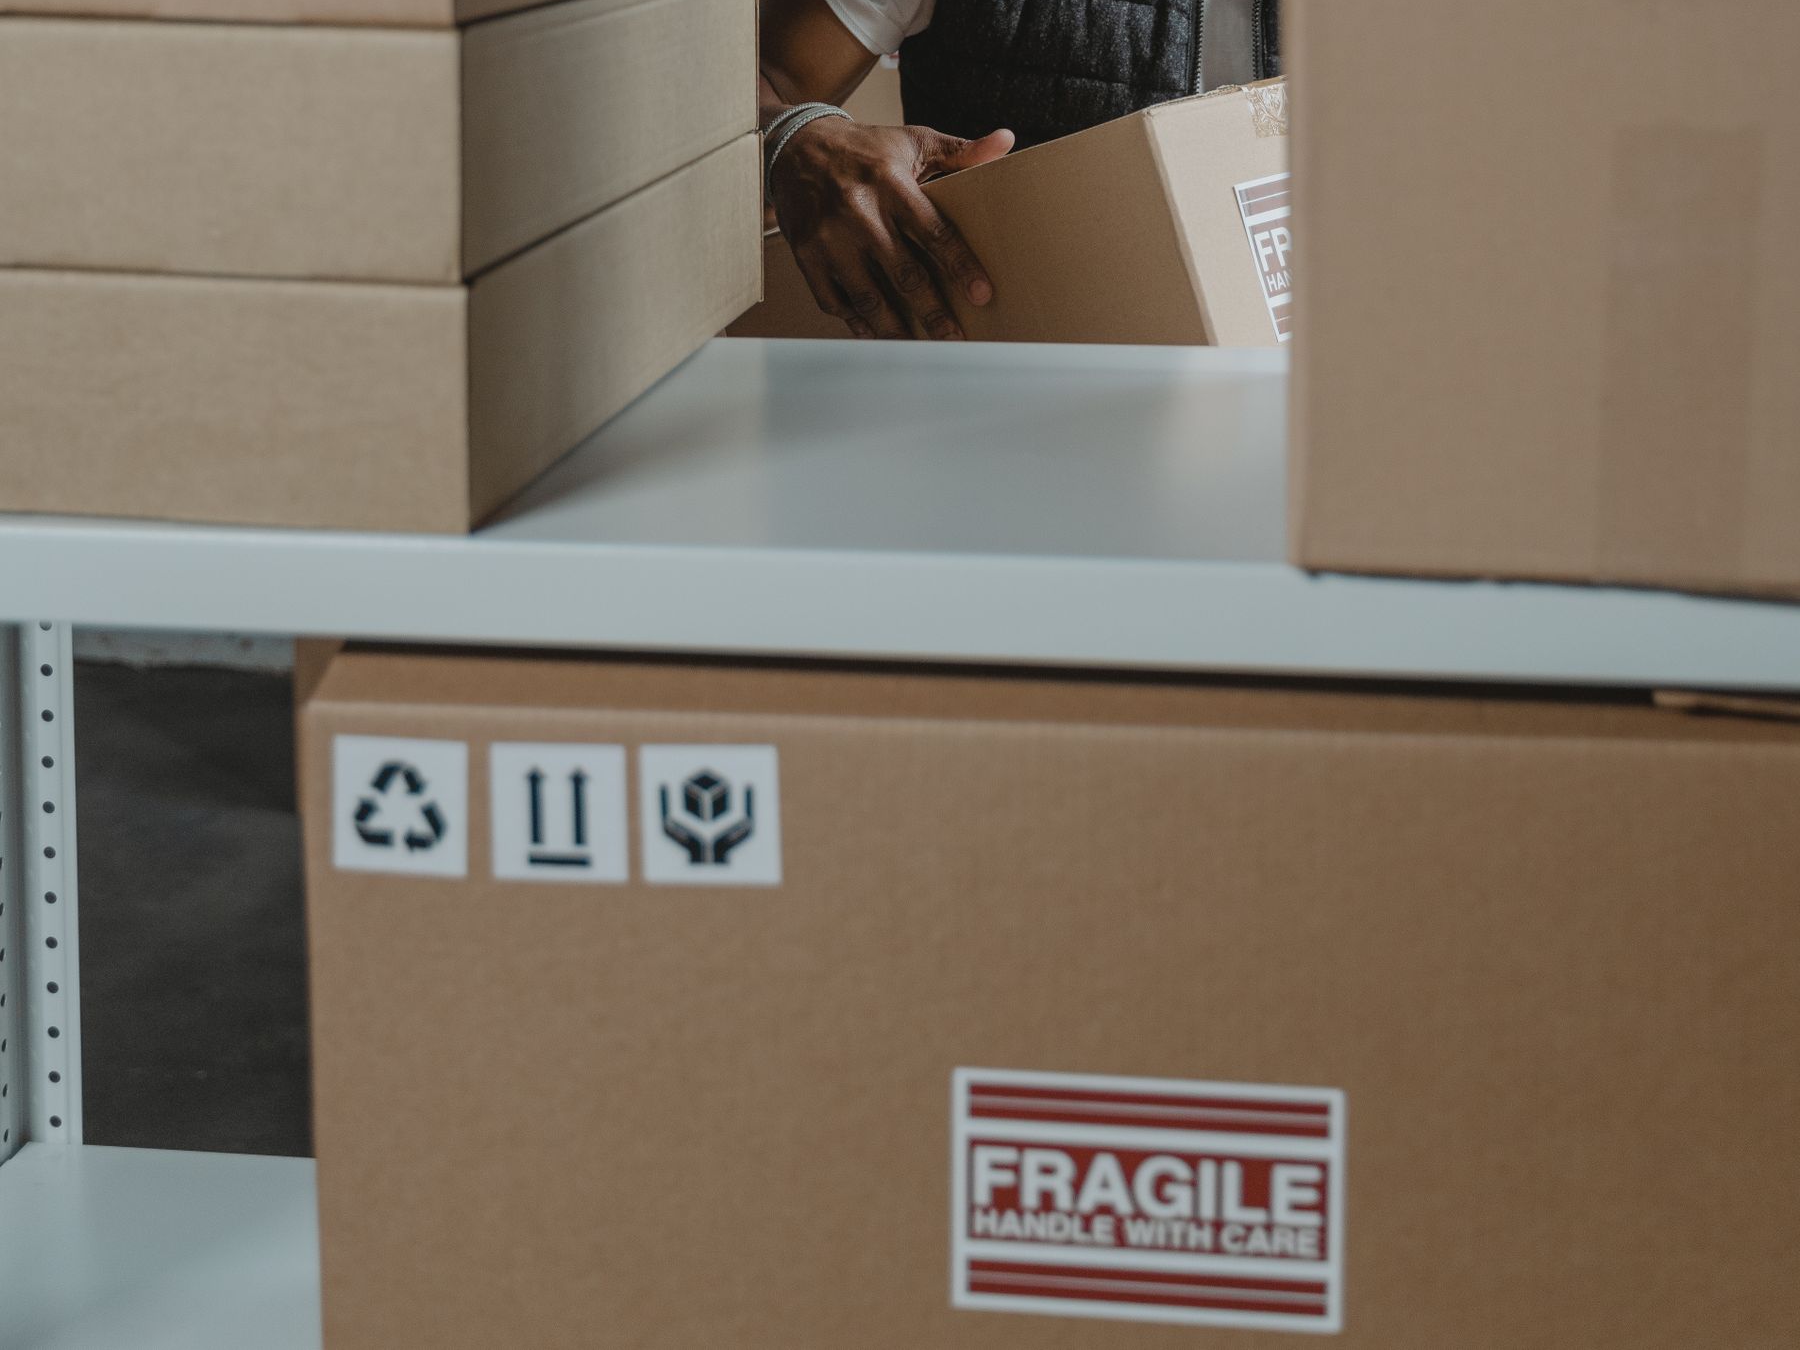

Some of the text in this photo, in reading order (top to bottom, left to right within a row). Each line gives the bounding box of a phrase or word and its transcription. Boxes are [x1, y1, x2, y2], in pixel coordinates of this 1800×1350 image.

[972, 1144, 1323, 1227] FRAGILE
[973, 1208, 1320, 1257] HANDLE WITH CARE
